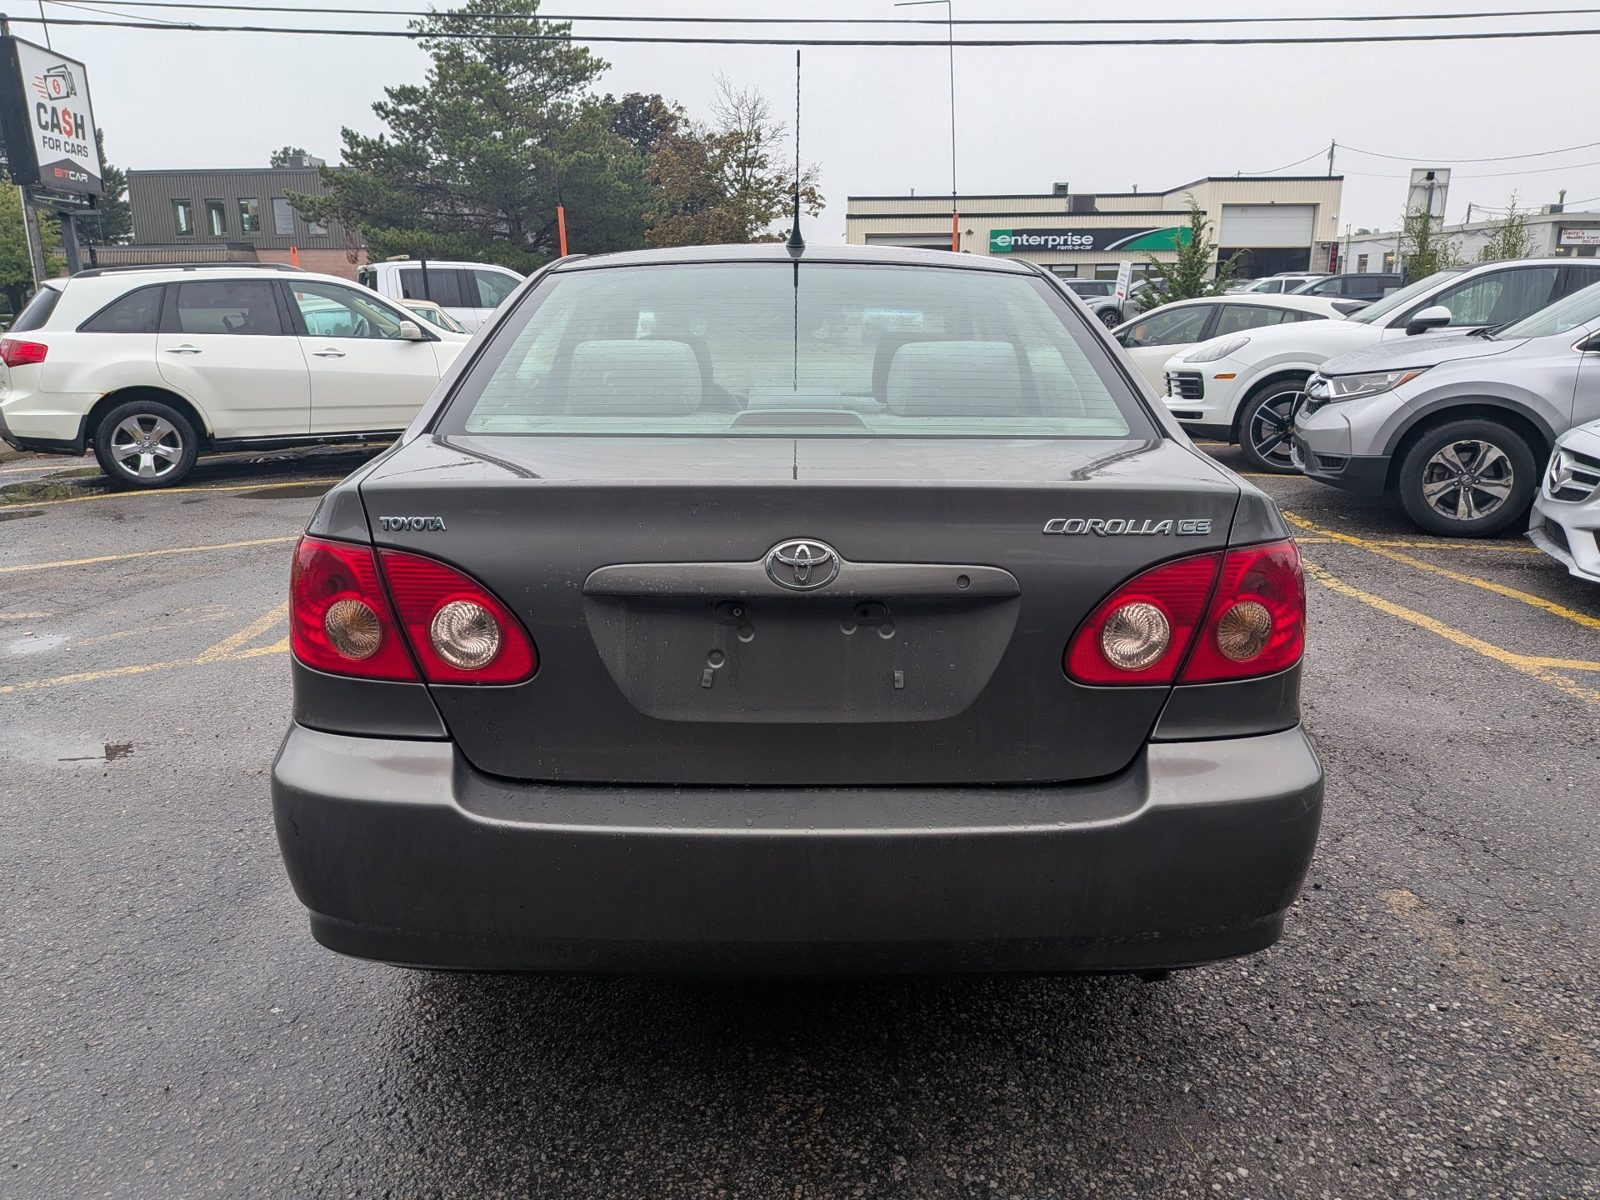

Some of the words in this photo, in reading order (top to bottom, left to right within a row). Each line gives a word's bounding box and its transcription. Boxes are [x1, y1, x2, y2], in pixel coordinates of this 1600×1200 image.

[42, 135, 62, 152] FOR
[64, 141, 89, 158] CARS
[54, 168, 89, 183] BITCAR
[992, 232, 1094, 248] enterprise
[379, 516, 447, 531] TOYOTA
[1042, 518, 1174, 537] COROLLA
[1178, 519, 1213, 535] CE
